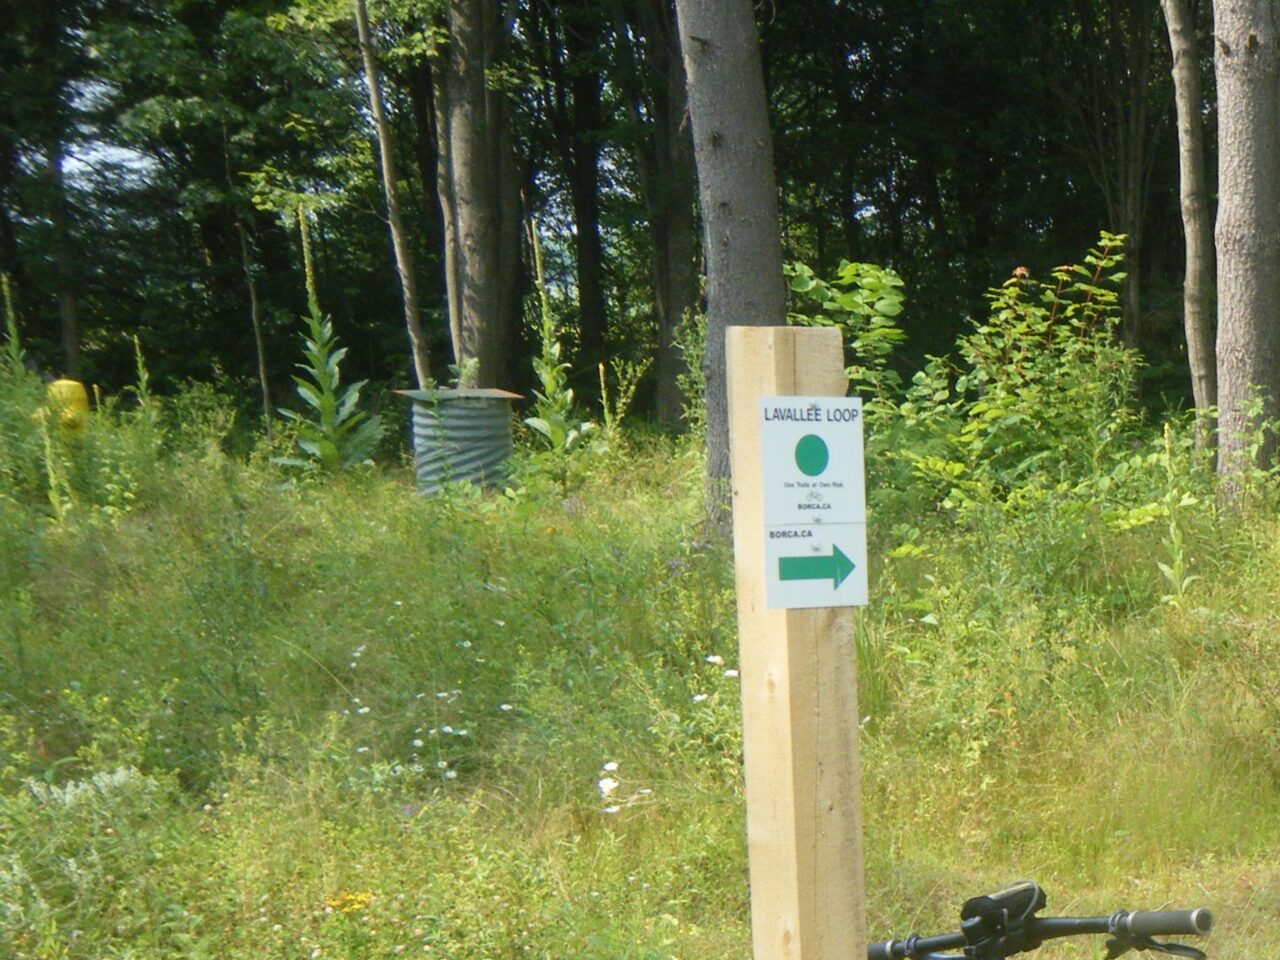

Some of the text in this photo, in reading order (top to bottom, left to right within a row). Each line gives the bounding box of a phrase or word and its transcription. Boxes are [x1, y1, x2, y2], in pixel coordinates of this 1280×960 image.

[763, 407, 859, 422] LAVALLEE LOOP
[769, 530, 813, 539] BORCA.CA
